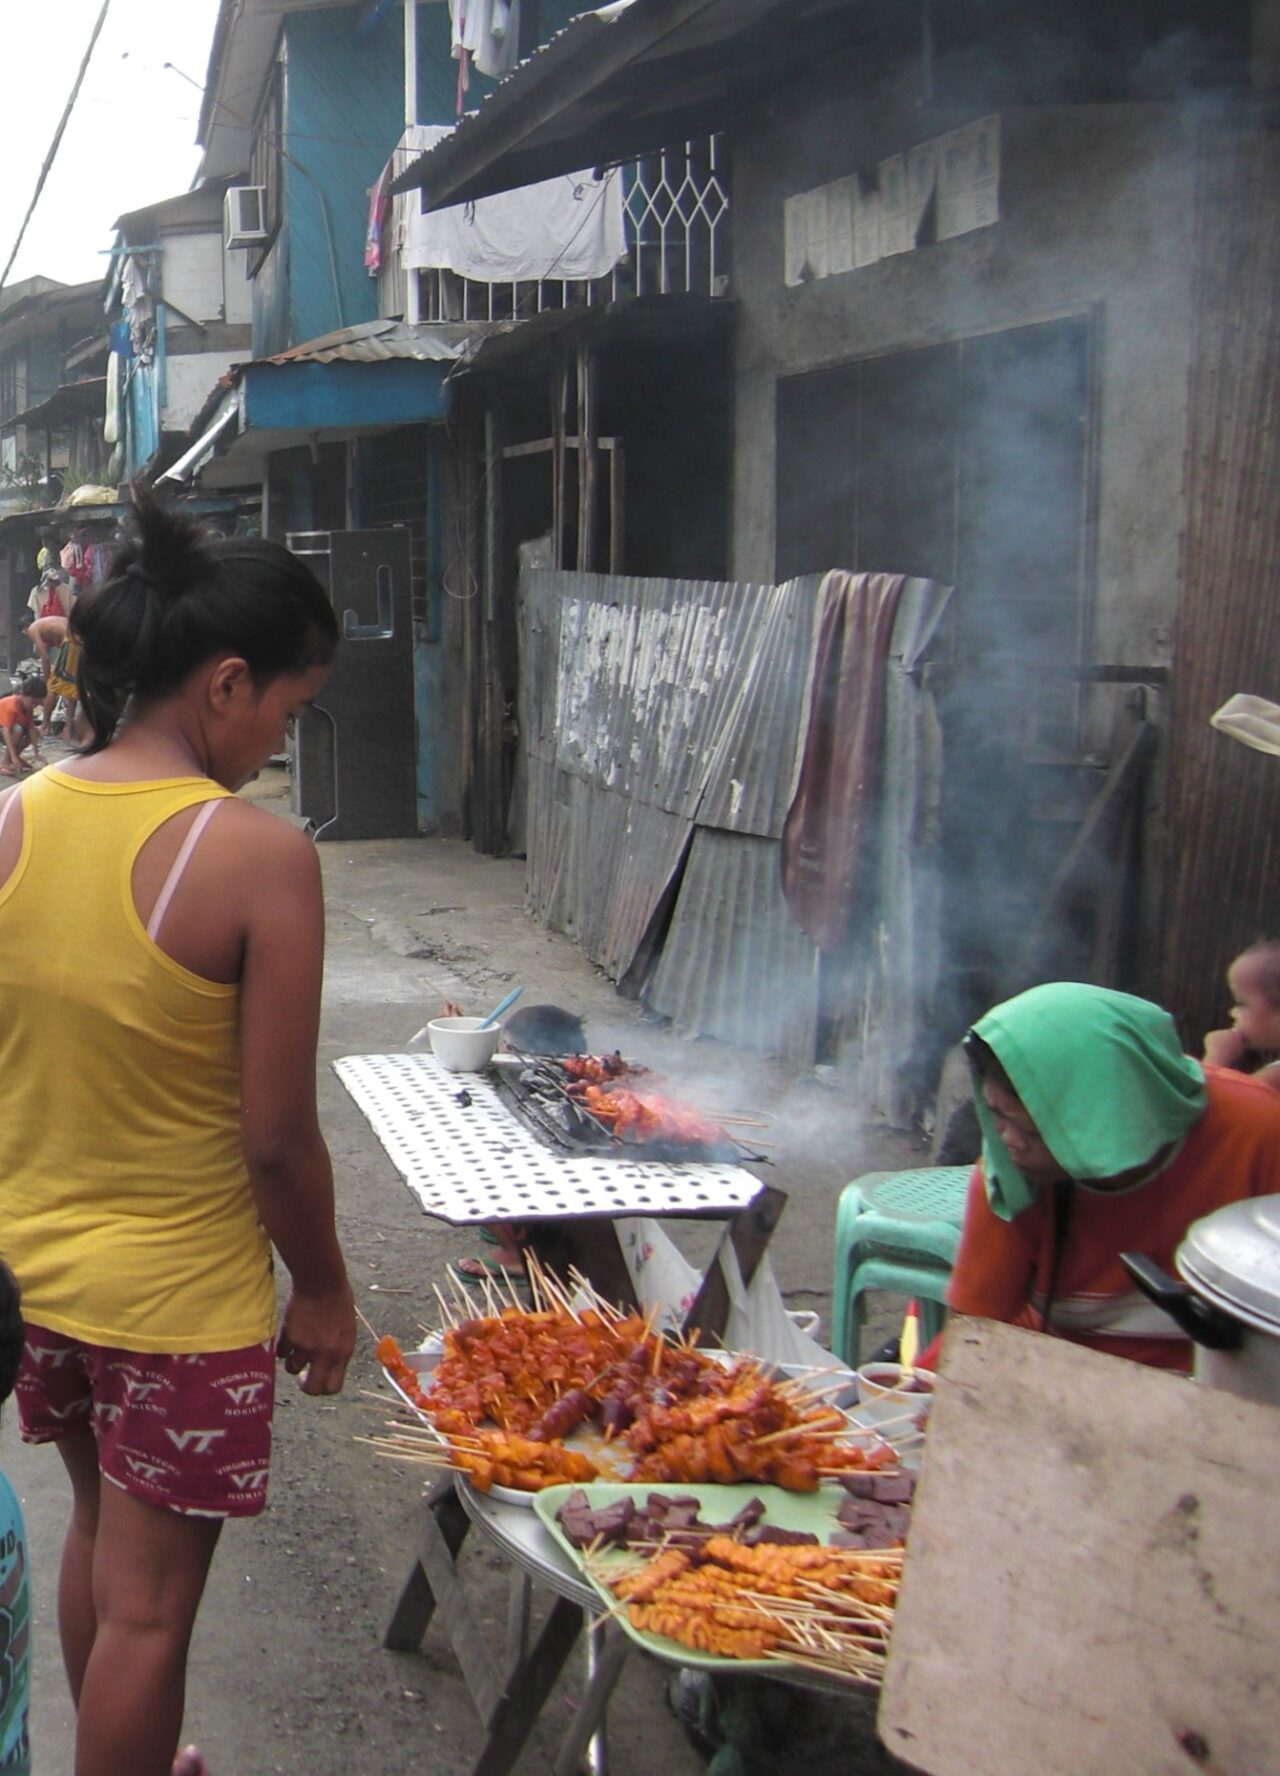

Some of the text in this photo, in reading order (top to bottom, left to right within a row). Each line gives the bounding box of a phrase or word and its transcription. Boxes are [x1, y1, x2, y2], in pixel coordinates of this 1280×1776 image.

[209, 1371, 249, 1388] VIRGINIA
[225, 1382, 264, 1405] VT
[165, 1427, 226, 1453] VT
[125, 1454, 166, 1479] VT
[229, 1468, 270, 1488] VT
